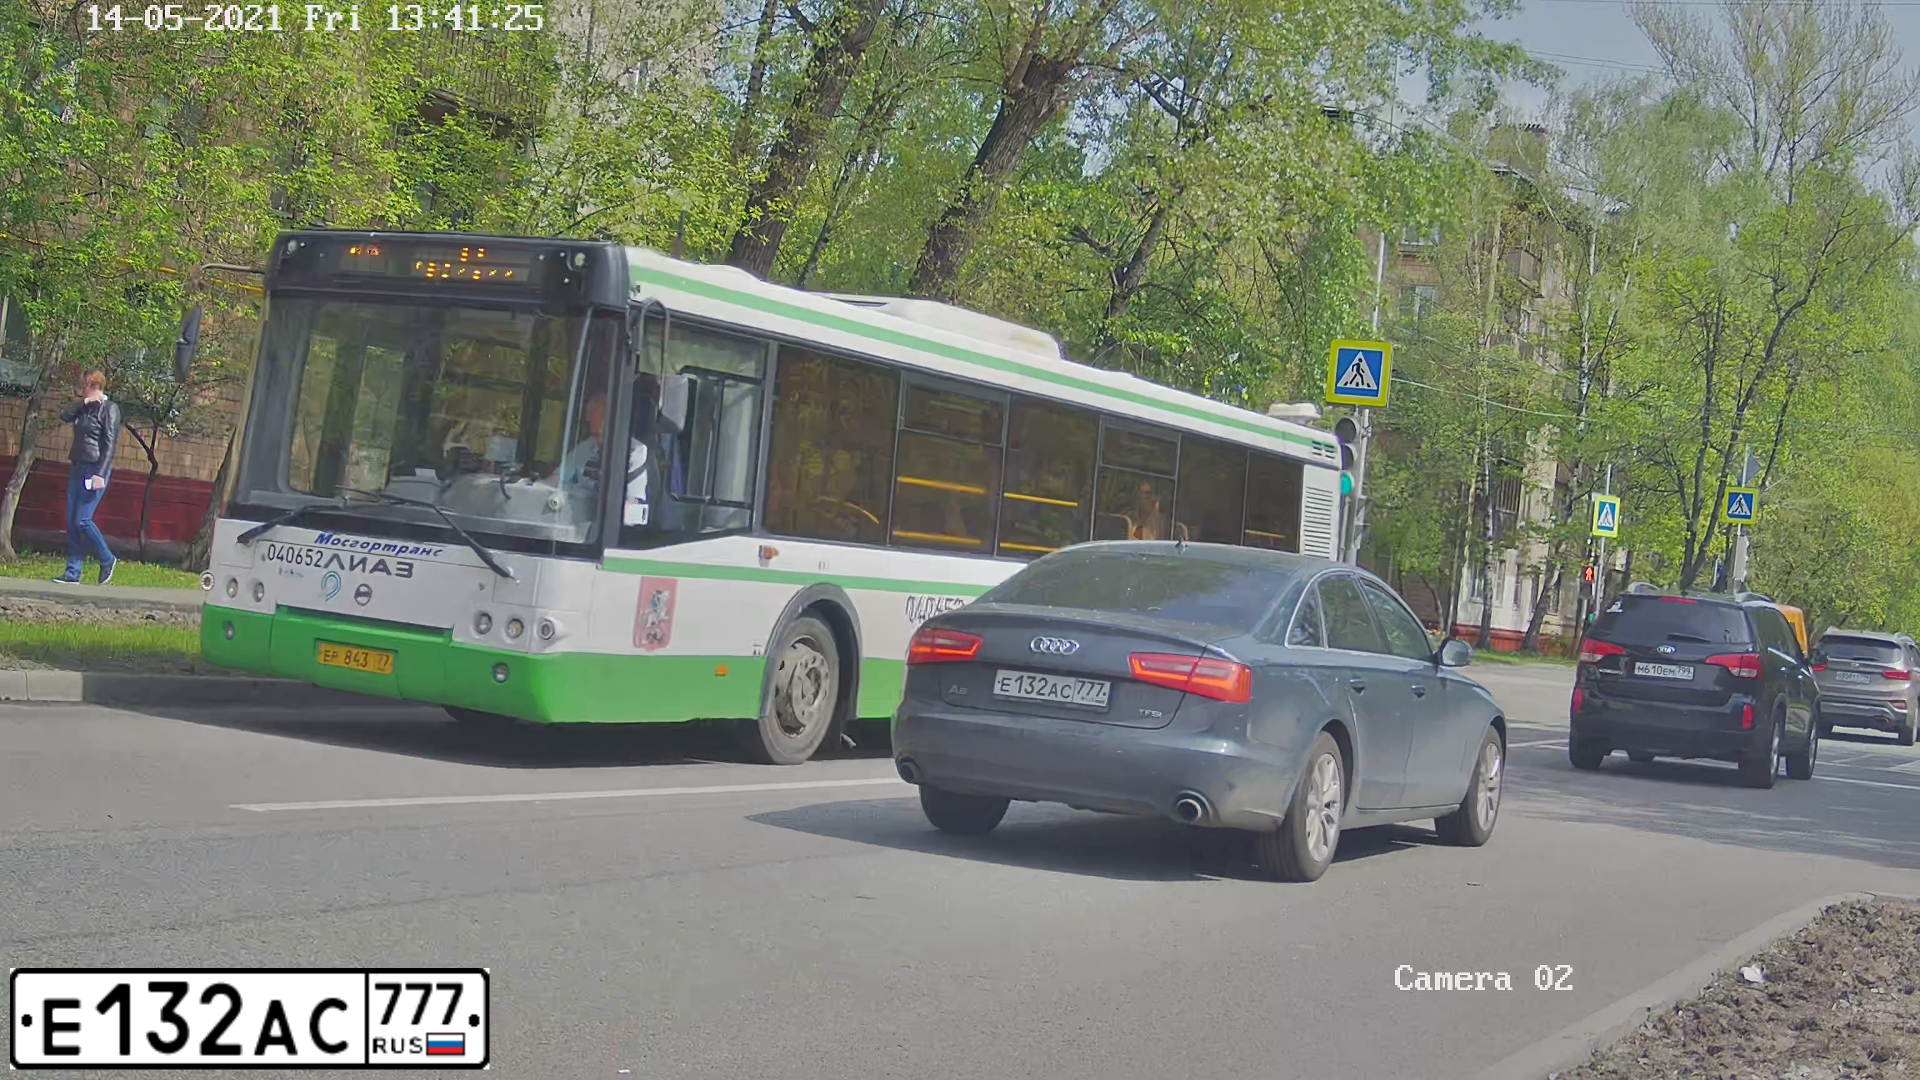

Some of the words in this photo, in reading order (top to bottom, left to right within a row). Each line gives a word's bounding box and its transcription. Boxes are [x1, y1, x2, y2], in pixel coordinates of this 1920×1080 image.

[267, 543, 324, 568] 040652
[314, 533, 443, 558] Мосгортранс
[323, 553, 414, 579] ЛИАЗ
[1077, 680, 1106, 697] 777
